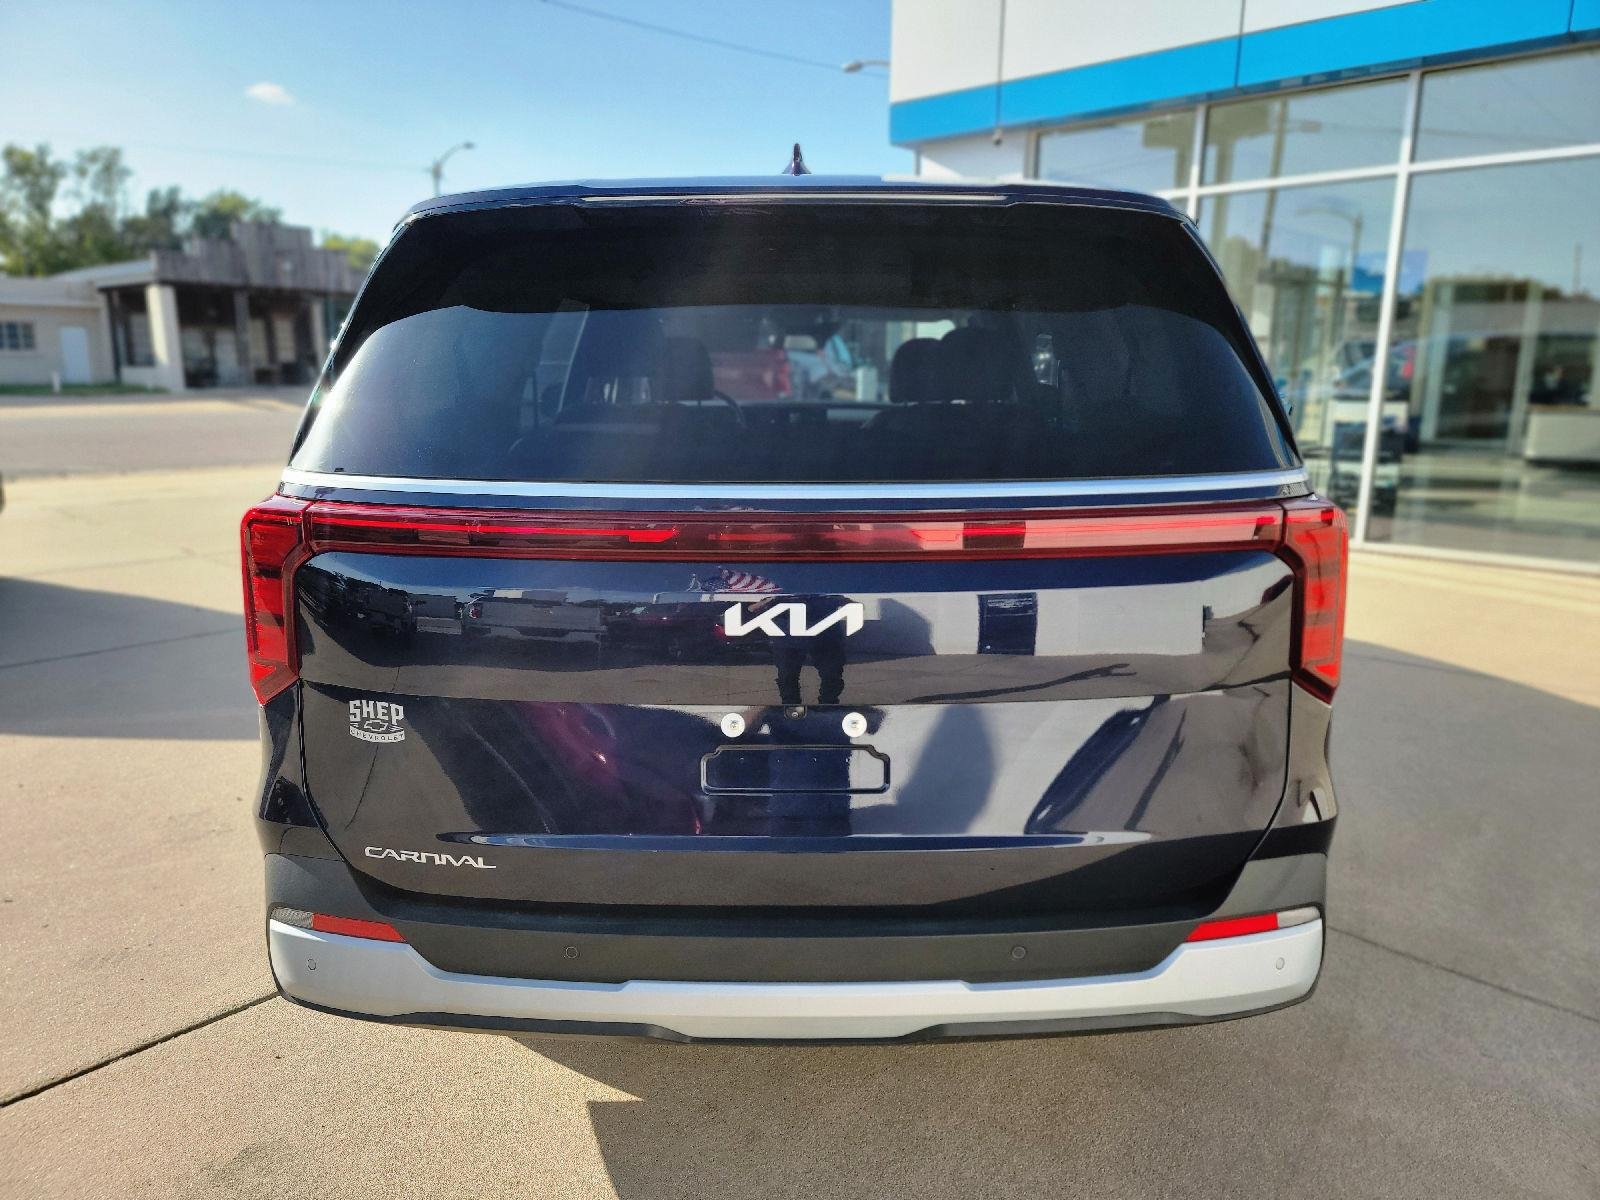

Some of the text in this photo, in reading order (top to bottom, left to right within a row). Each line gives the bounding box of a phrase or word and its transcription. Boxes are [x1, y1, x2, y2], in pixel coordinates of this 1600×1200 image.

[724, 602, 864, 637] KIA
[349, 699, 404, 726] SHEP
[350, 727, 405, 743] CHEVROLET
[364, 846, 497, 869] CARNIVAL
